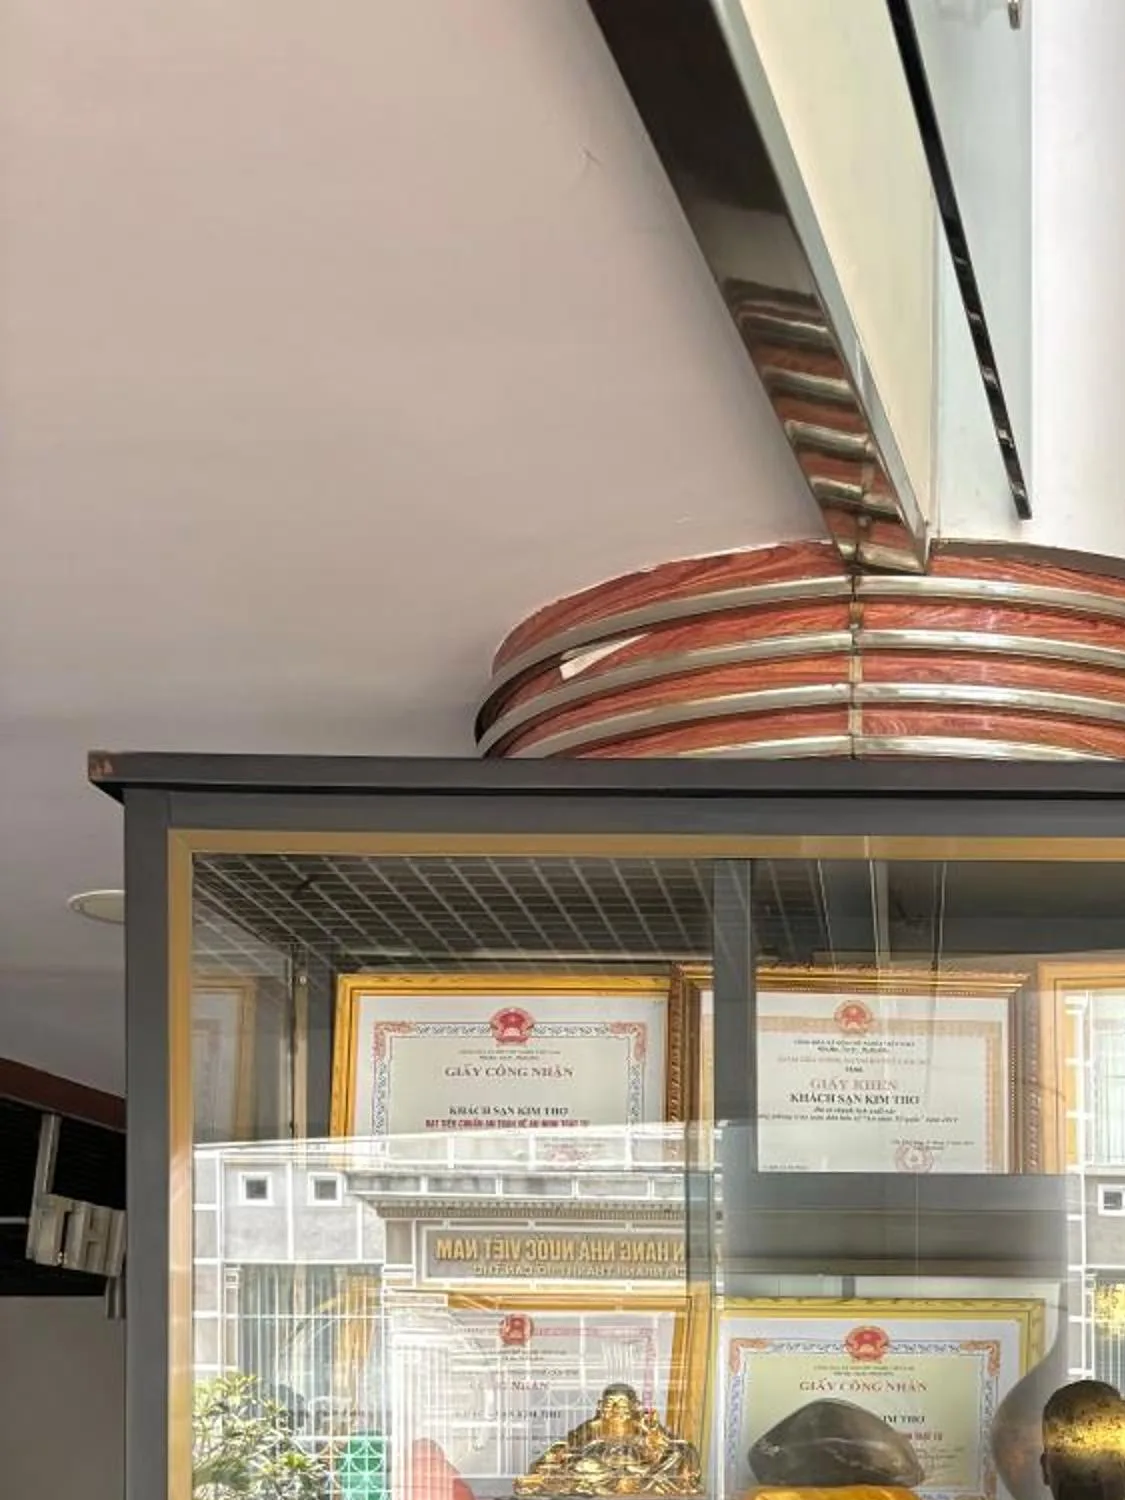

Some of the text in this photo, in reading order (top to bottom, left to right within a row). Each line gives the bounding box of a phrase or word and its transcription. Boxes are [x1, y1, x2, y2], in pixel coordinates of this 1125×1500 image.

[485, 1063, 528, 1077] CÔNG
[865, 1094, 892, 1105] KIM
[518, 1106, 541, 1116] KIM
[839, 1379, 882, 1392] CÔNG
